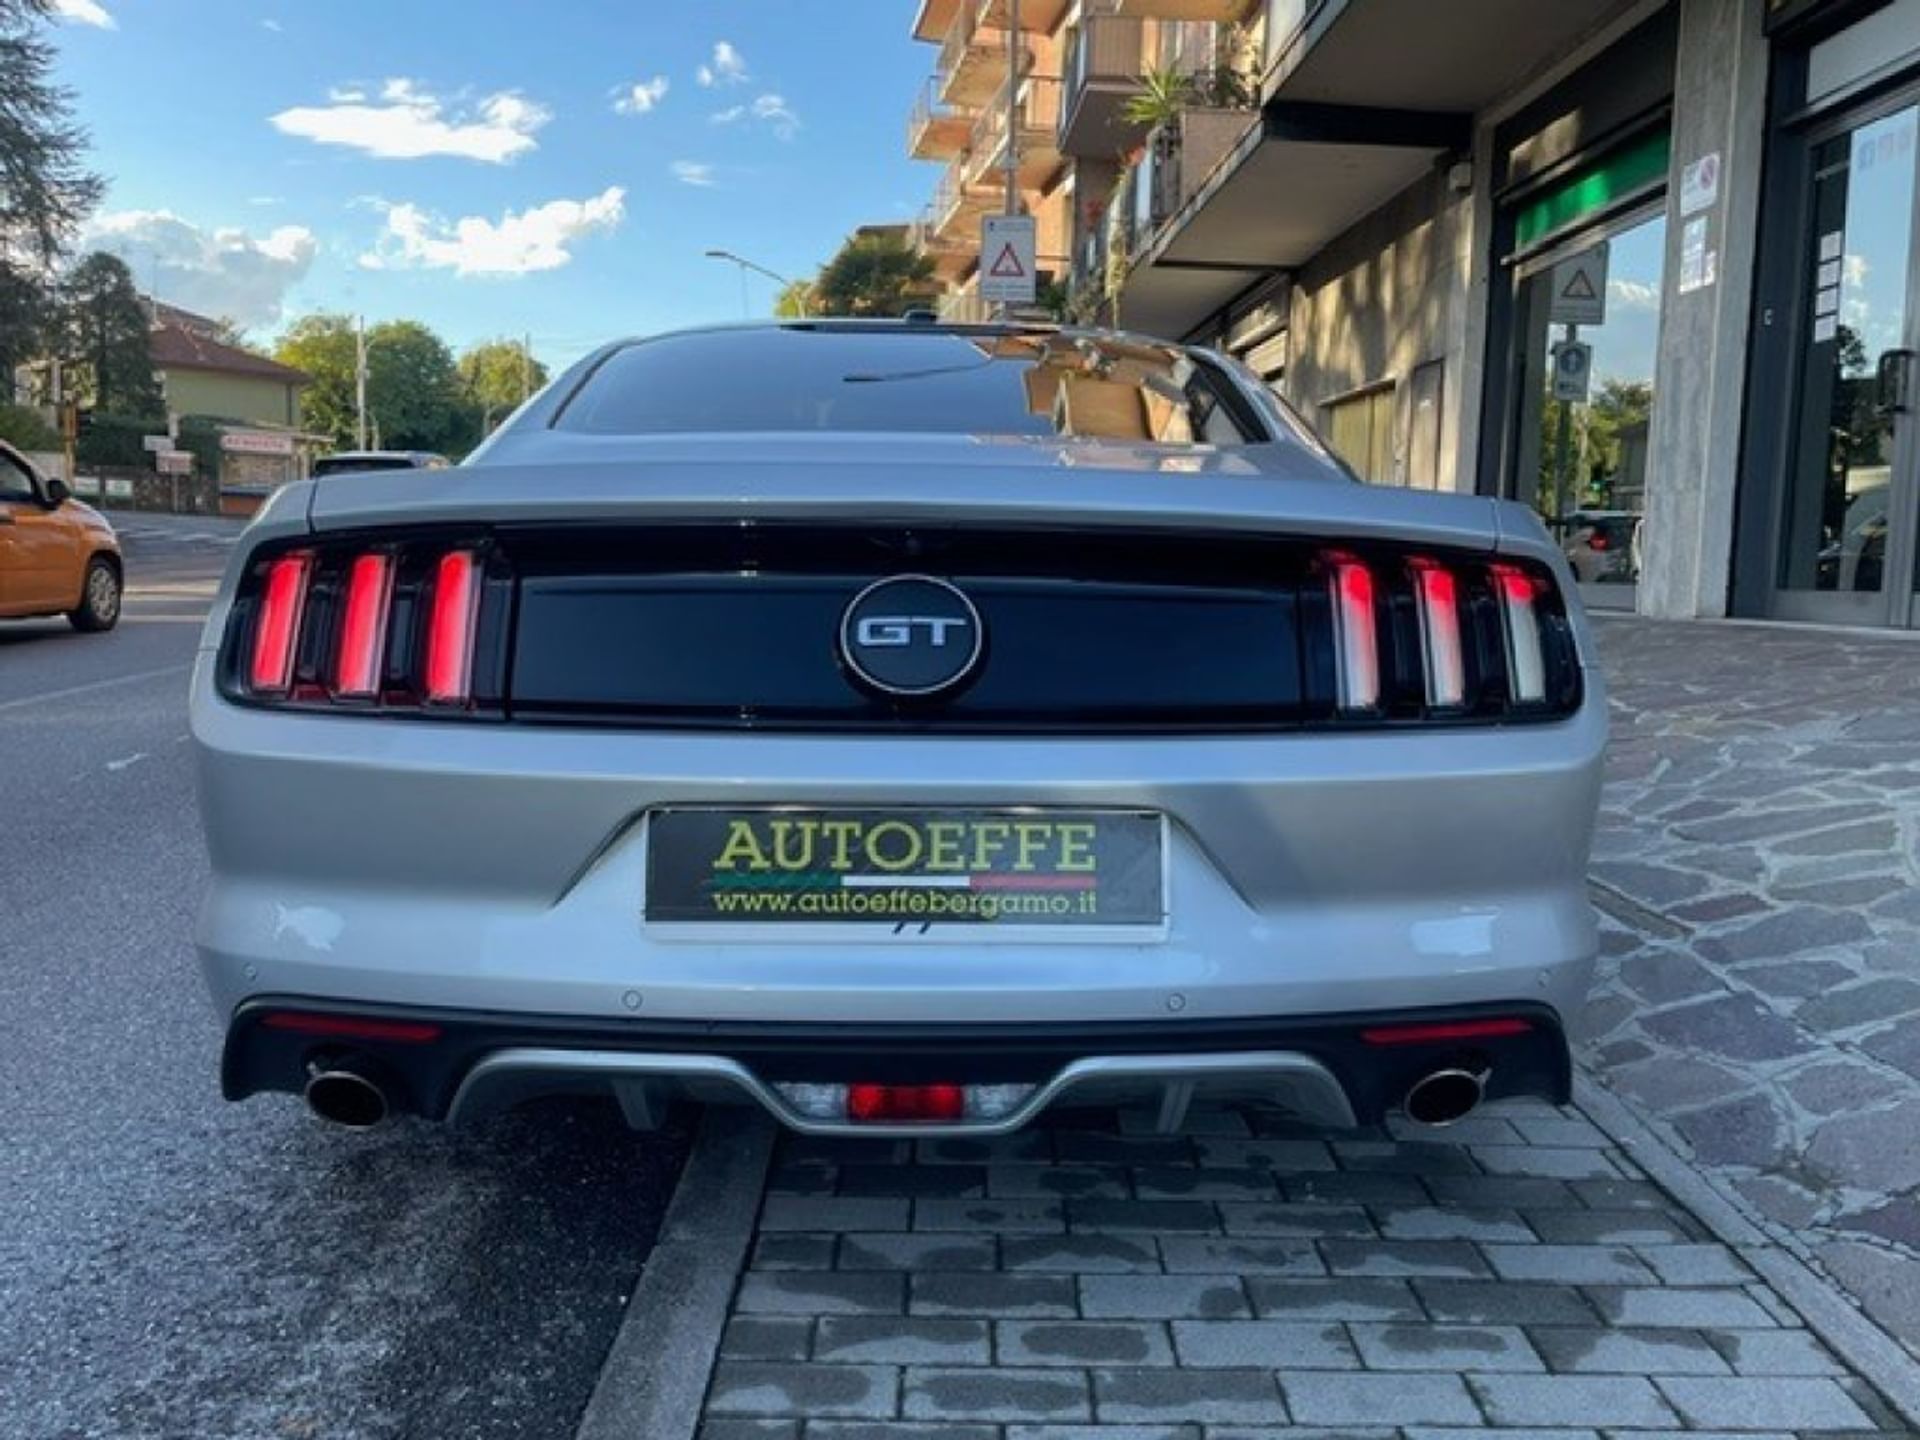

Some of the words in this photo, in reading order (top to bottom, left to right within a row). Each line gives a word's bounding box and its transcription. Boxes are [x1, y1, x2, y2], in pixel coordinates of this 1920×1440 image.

[858, 616, 967, 646] GT
[712, 820, 1097, 871] AUTOEFFE
[712, 889, 1097, 919] www.autoeffebergamo.it
